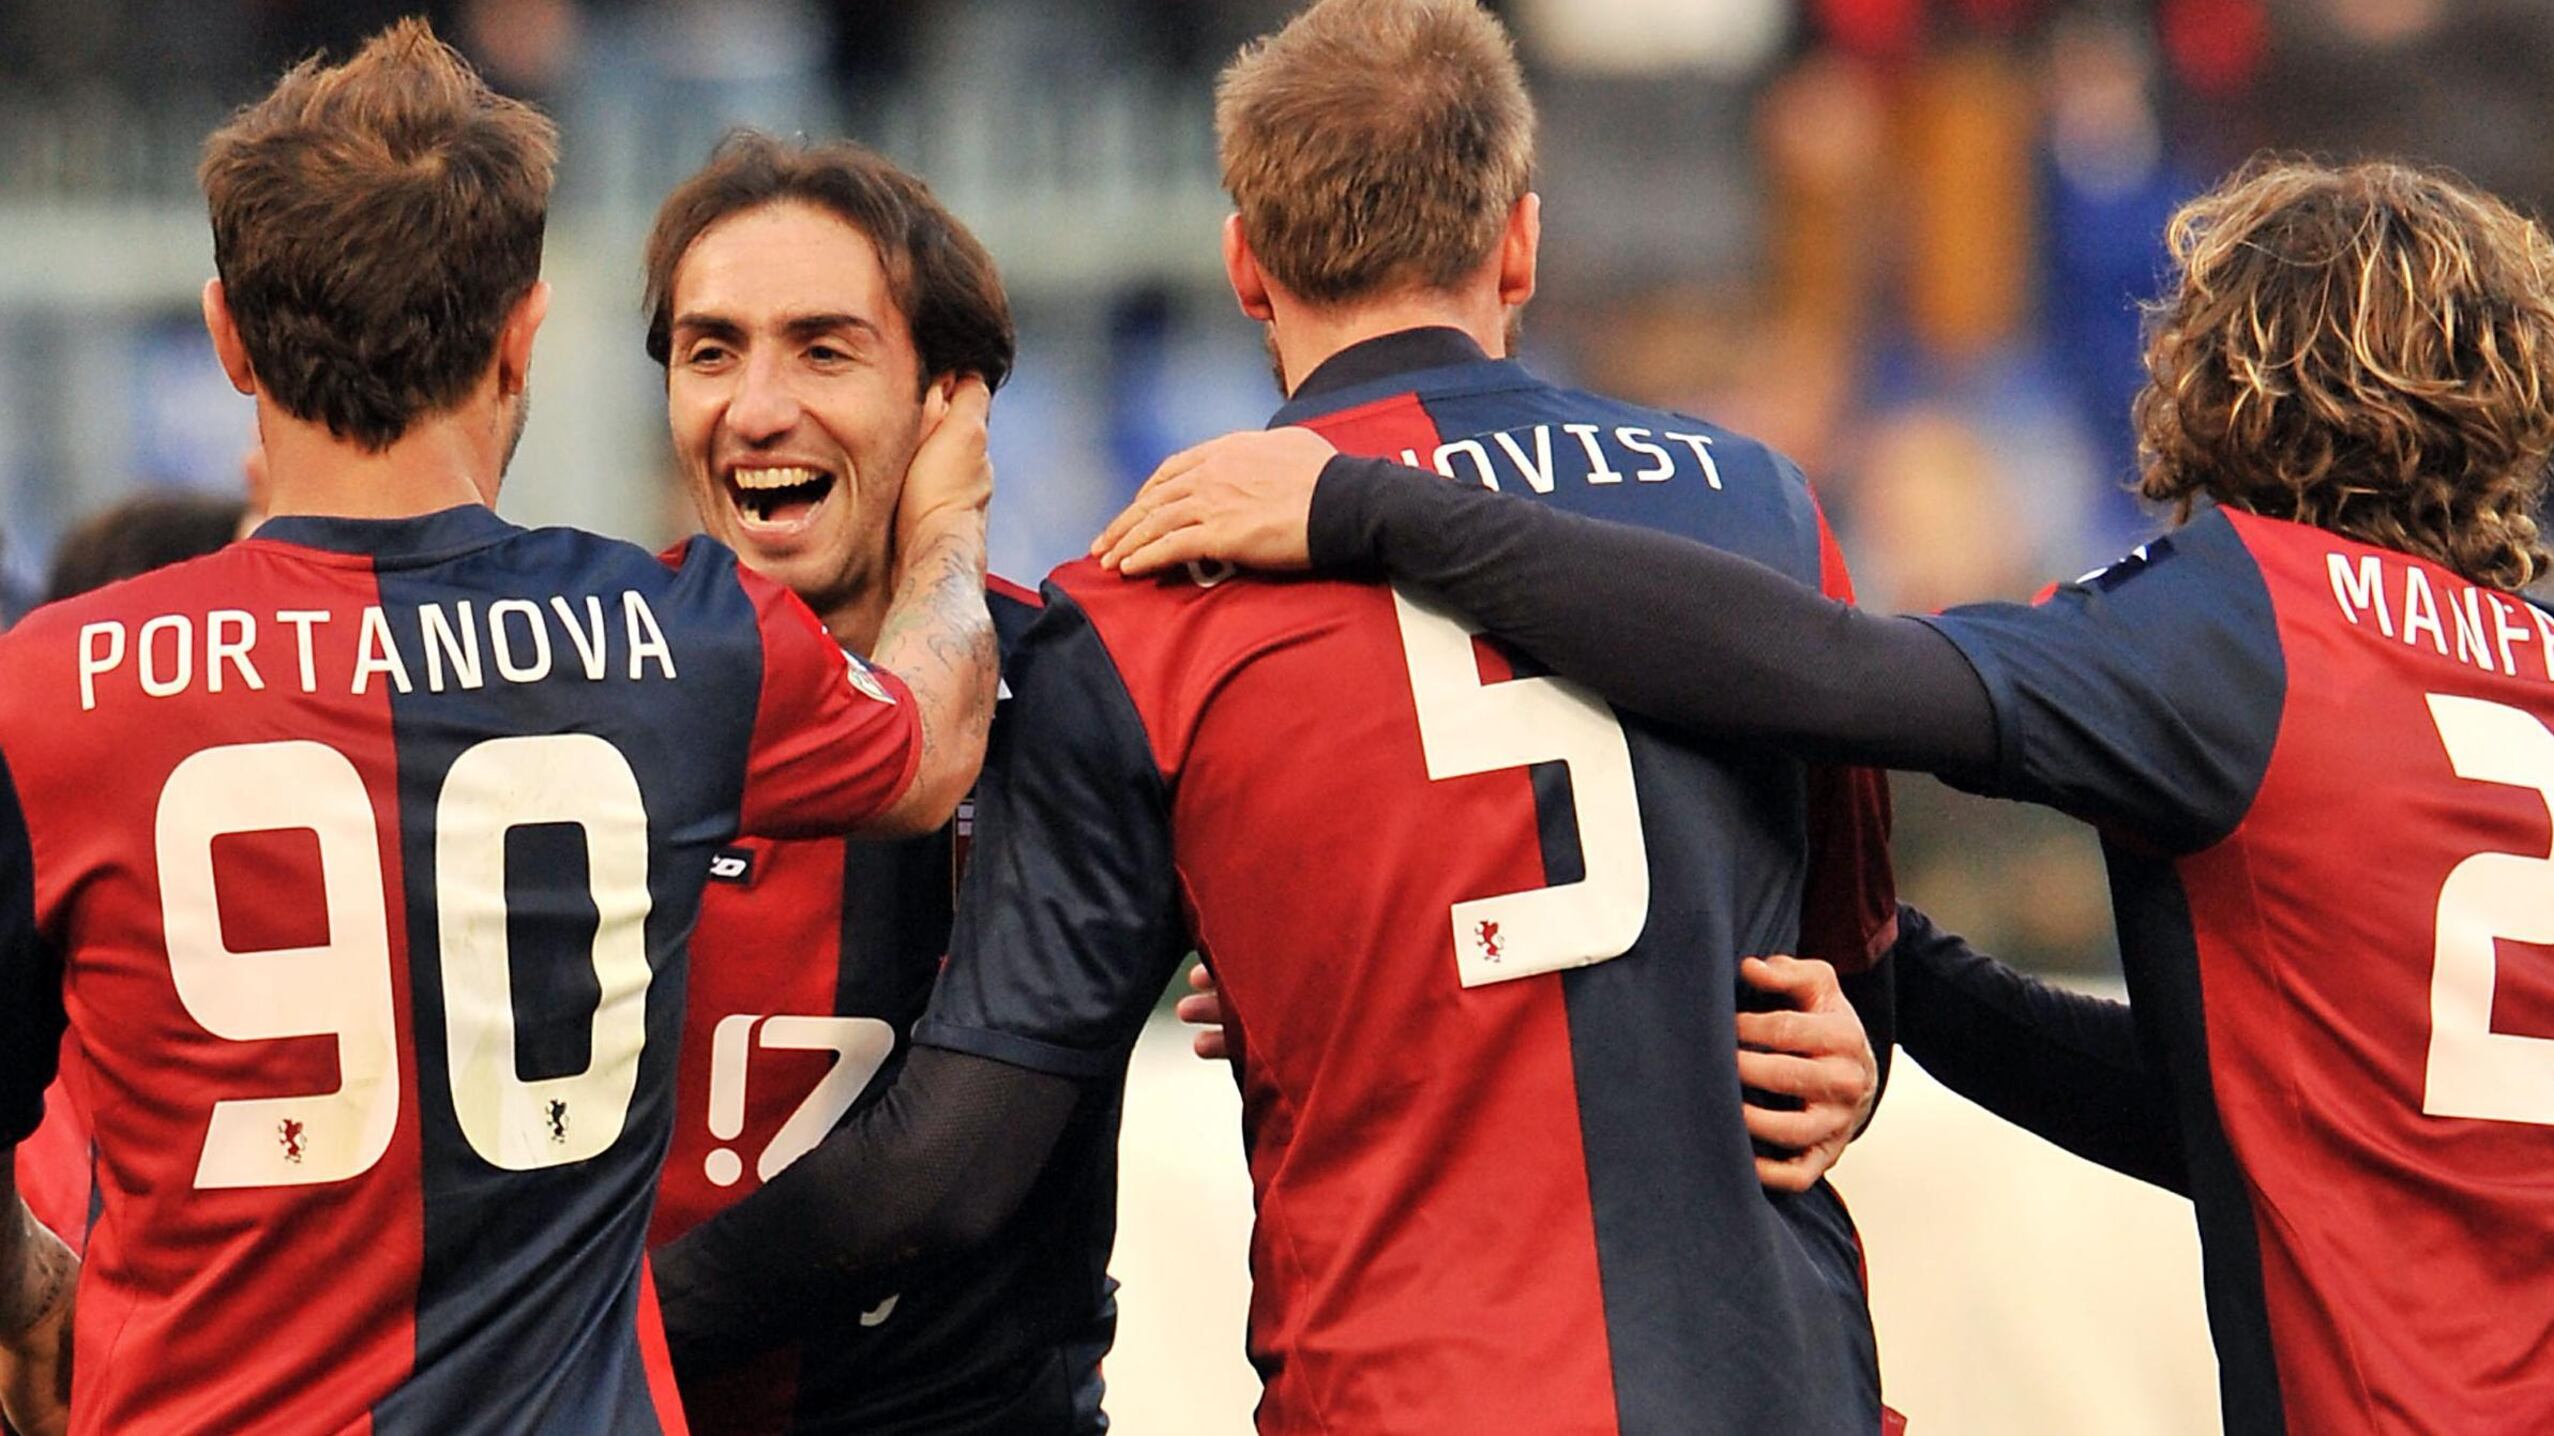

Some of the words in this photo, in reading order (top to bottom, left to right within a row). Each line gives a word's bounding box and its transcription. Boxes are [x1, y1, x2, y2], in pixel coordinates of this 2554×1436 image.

[78, 589, 677, 710] PORTANOVA
[1391, 582, 1650, 989] 5
[154, 733, 653, 1189] 90
[2423, 692, 2554, 1126] 2
